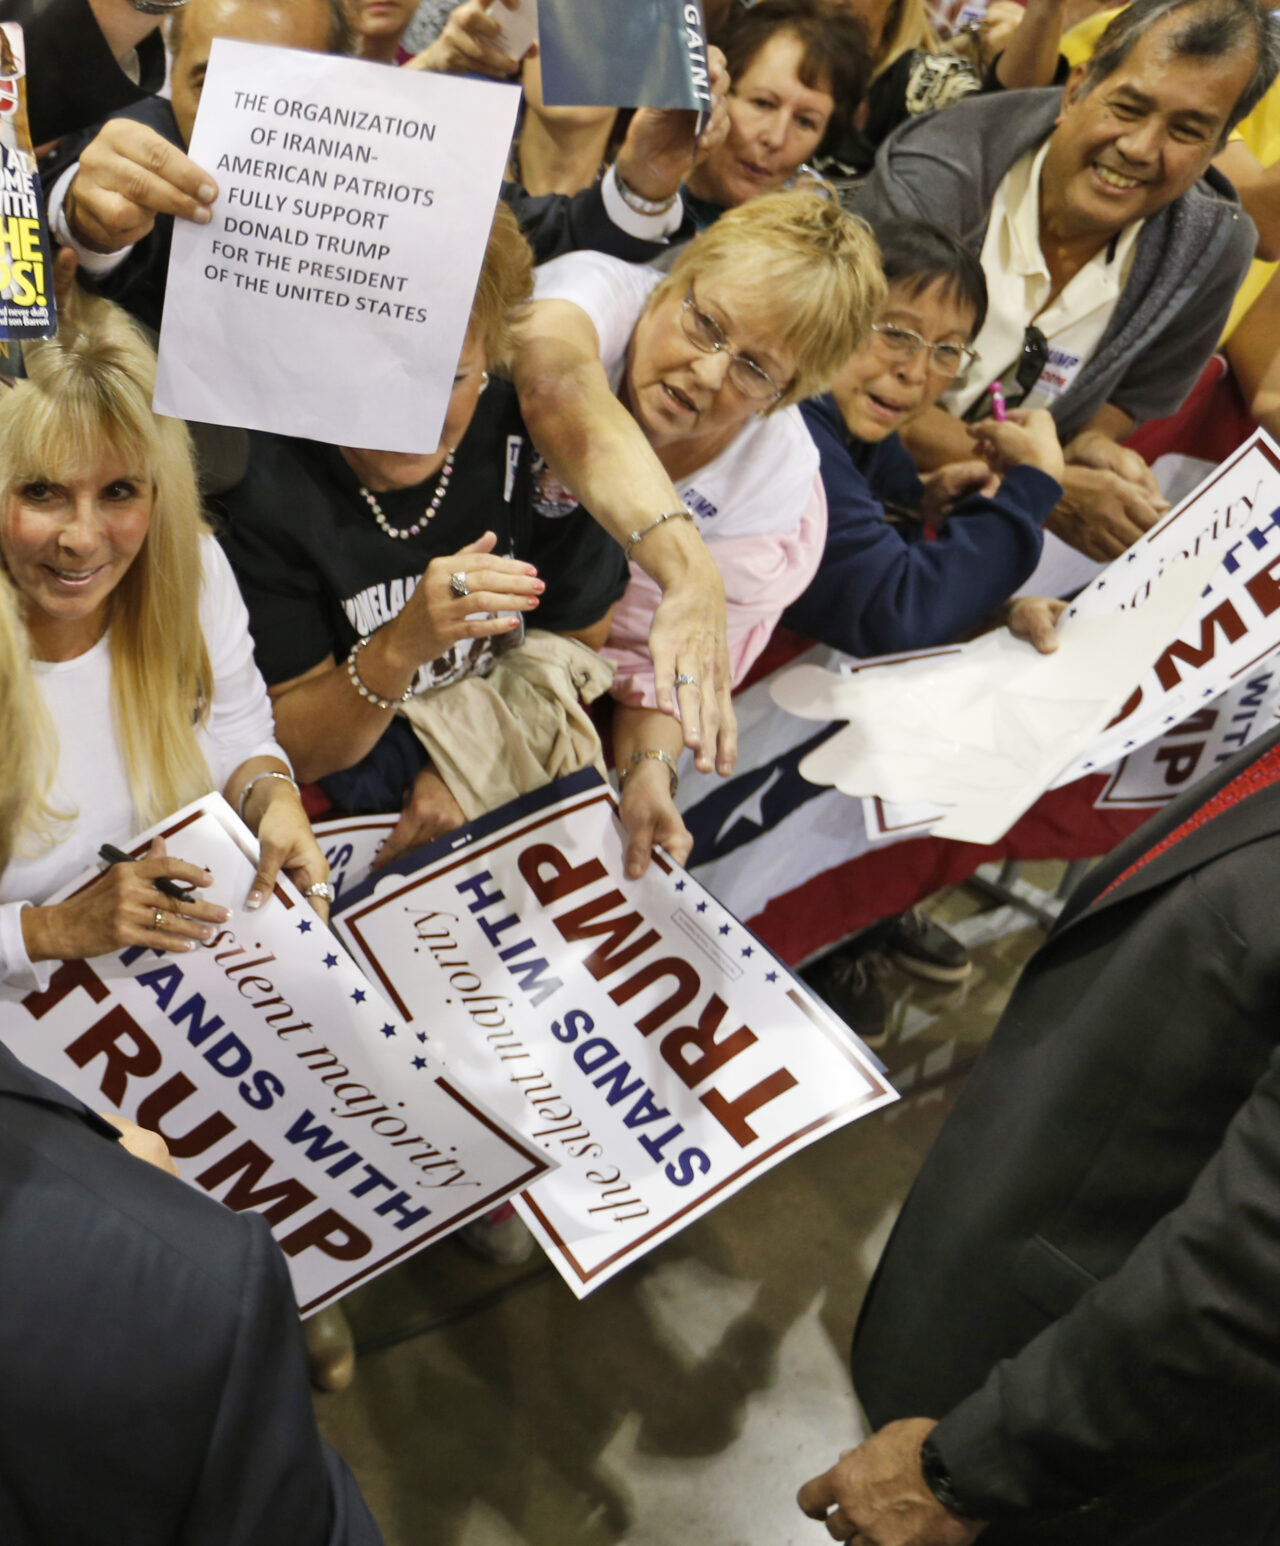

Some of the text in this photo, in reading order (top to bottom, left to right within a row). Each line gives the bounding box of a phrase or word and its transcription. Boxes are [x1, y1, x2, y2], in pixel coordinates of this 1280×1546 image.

[684, 4, 710, 101] GAIN!
[234, 91, 436, 141] THE ORGANIZATION
[250, 127, 378, 163] OF IRANIAN-
[7, 147, 28, 170] AT
[216, 154, 434, 207] AMERICAN PATRIOTS
[224, 217, 391, 261] DONALD TRUMP
[228, 187, 389, 231] FULLY SUPPORT
[204, 265, 428, 323] OF THE UNITED STATES
[211, 240, 409, 292] FOR THE PRESIDENT
[454, 869, 565, 1008] WITH
[517, 842, 799, 1149] TRUMP
[118, 945, 433, 1232] ANDS WITH
[199, 927, 483, 1190] silent majority
[404, 906, 650, 1225] the silent majority
[21, 957, 373, 1262] TRUMP
[550, 1008, 712, 1188] STANDS
